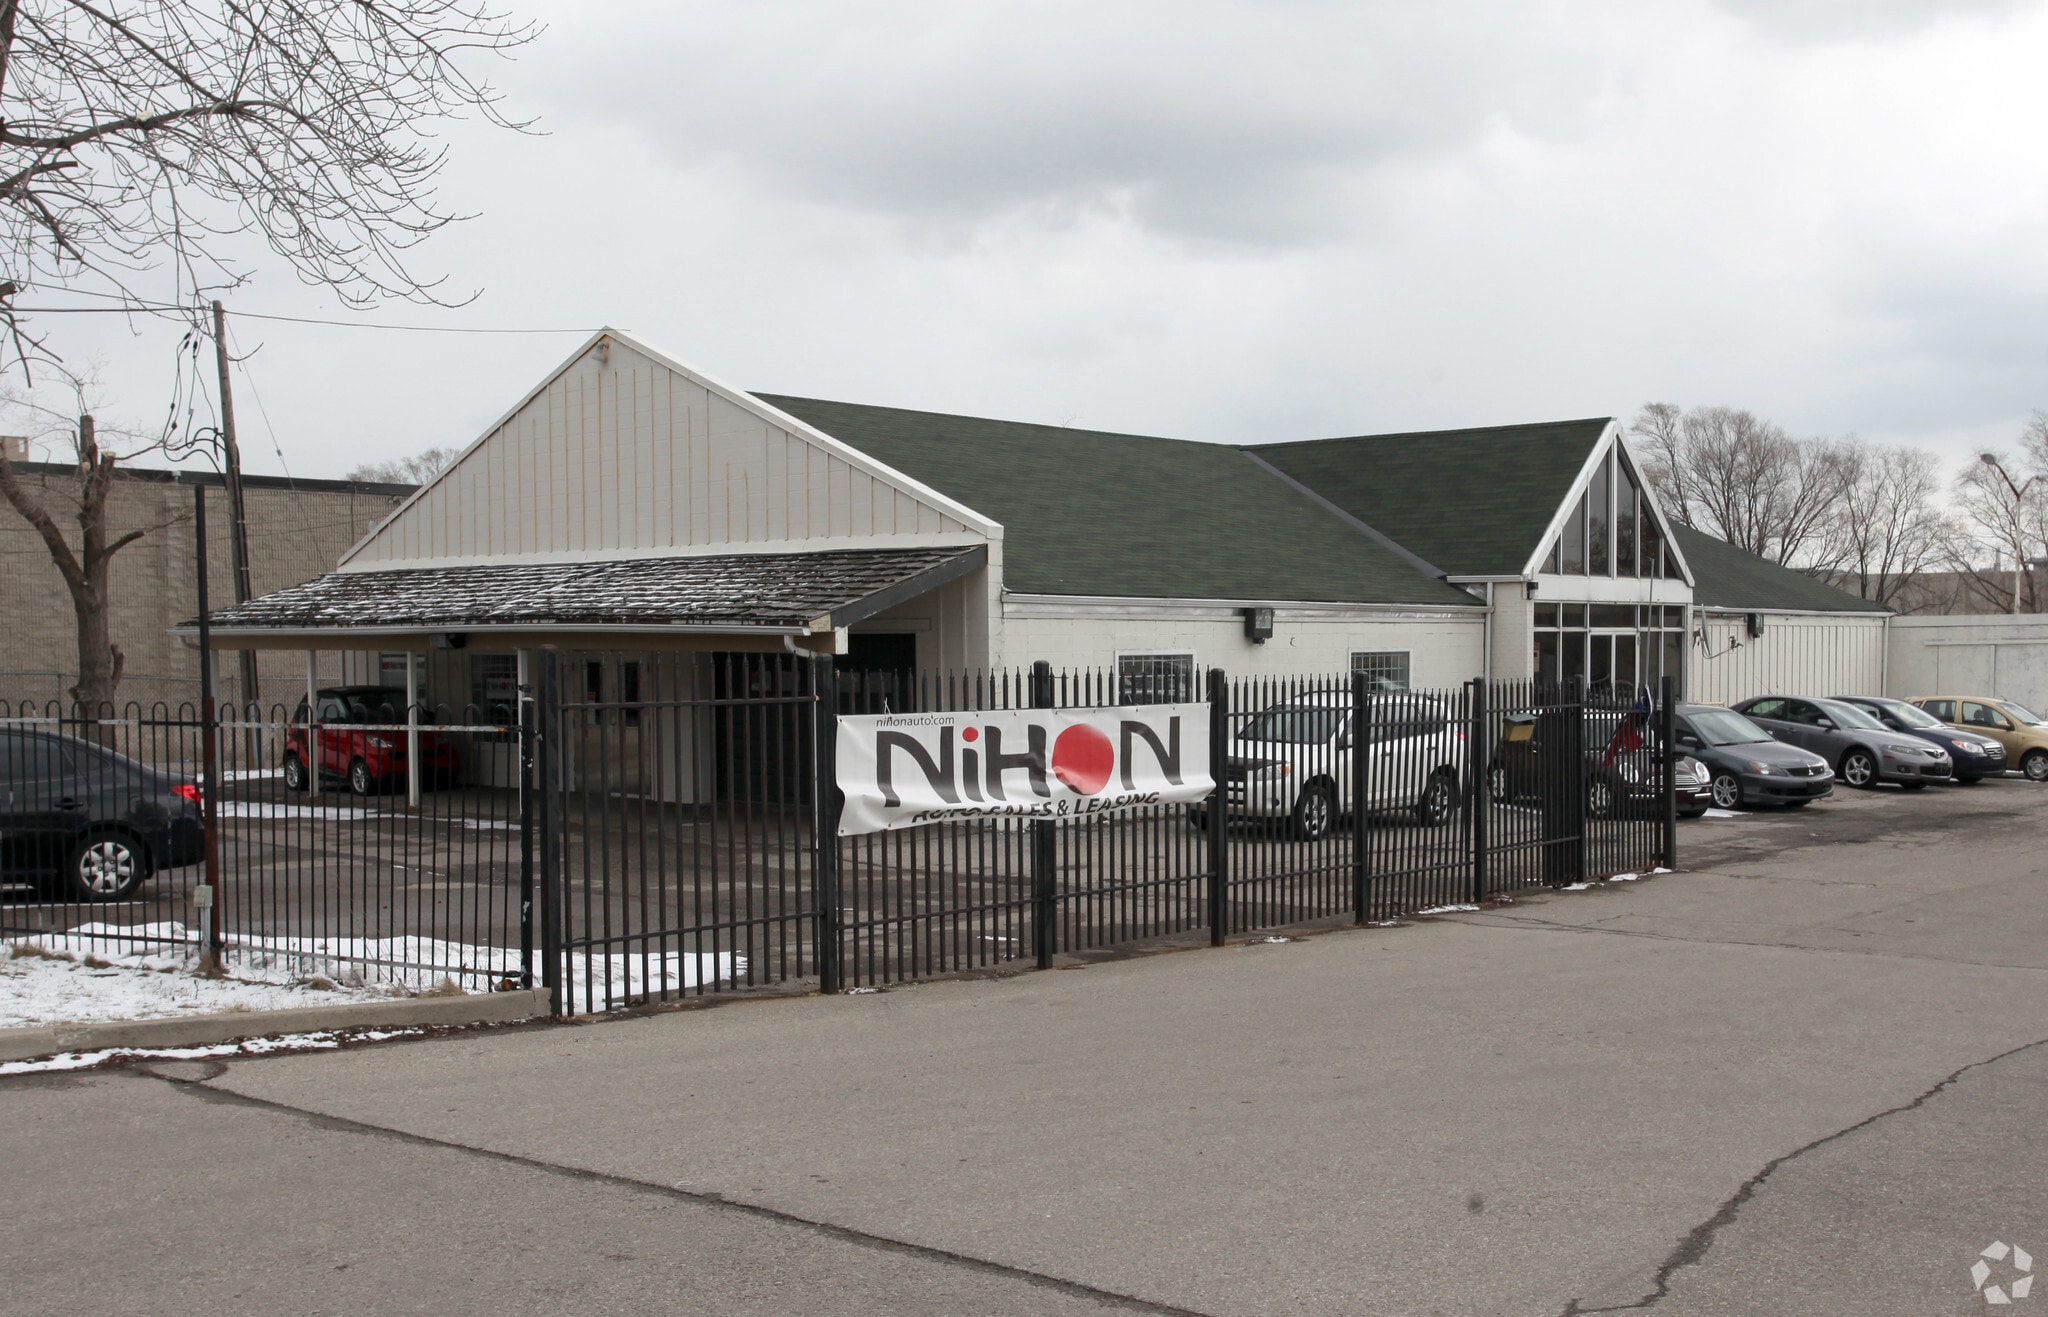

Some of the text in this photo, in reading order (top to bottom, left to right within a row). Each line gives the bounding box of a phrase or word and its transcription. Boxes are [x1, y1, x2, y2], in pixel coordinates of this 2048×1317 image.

[876, 716, 955, 727] nihonauto.com
[1057, 799, 1070, 816] &
[1073, 792, 1159, 814] LEASING
